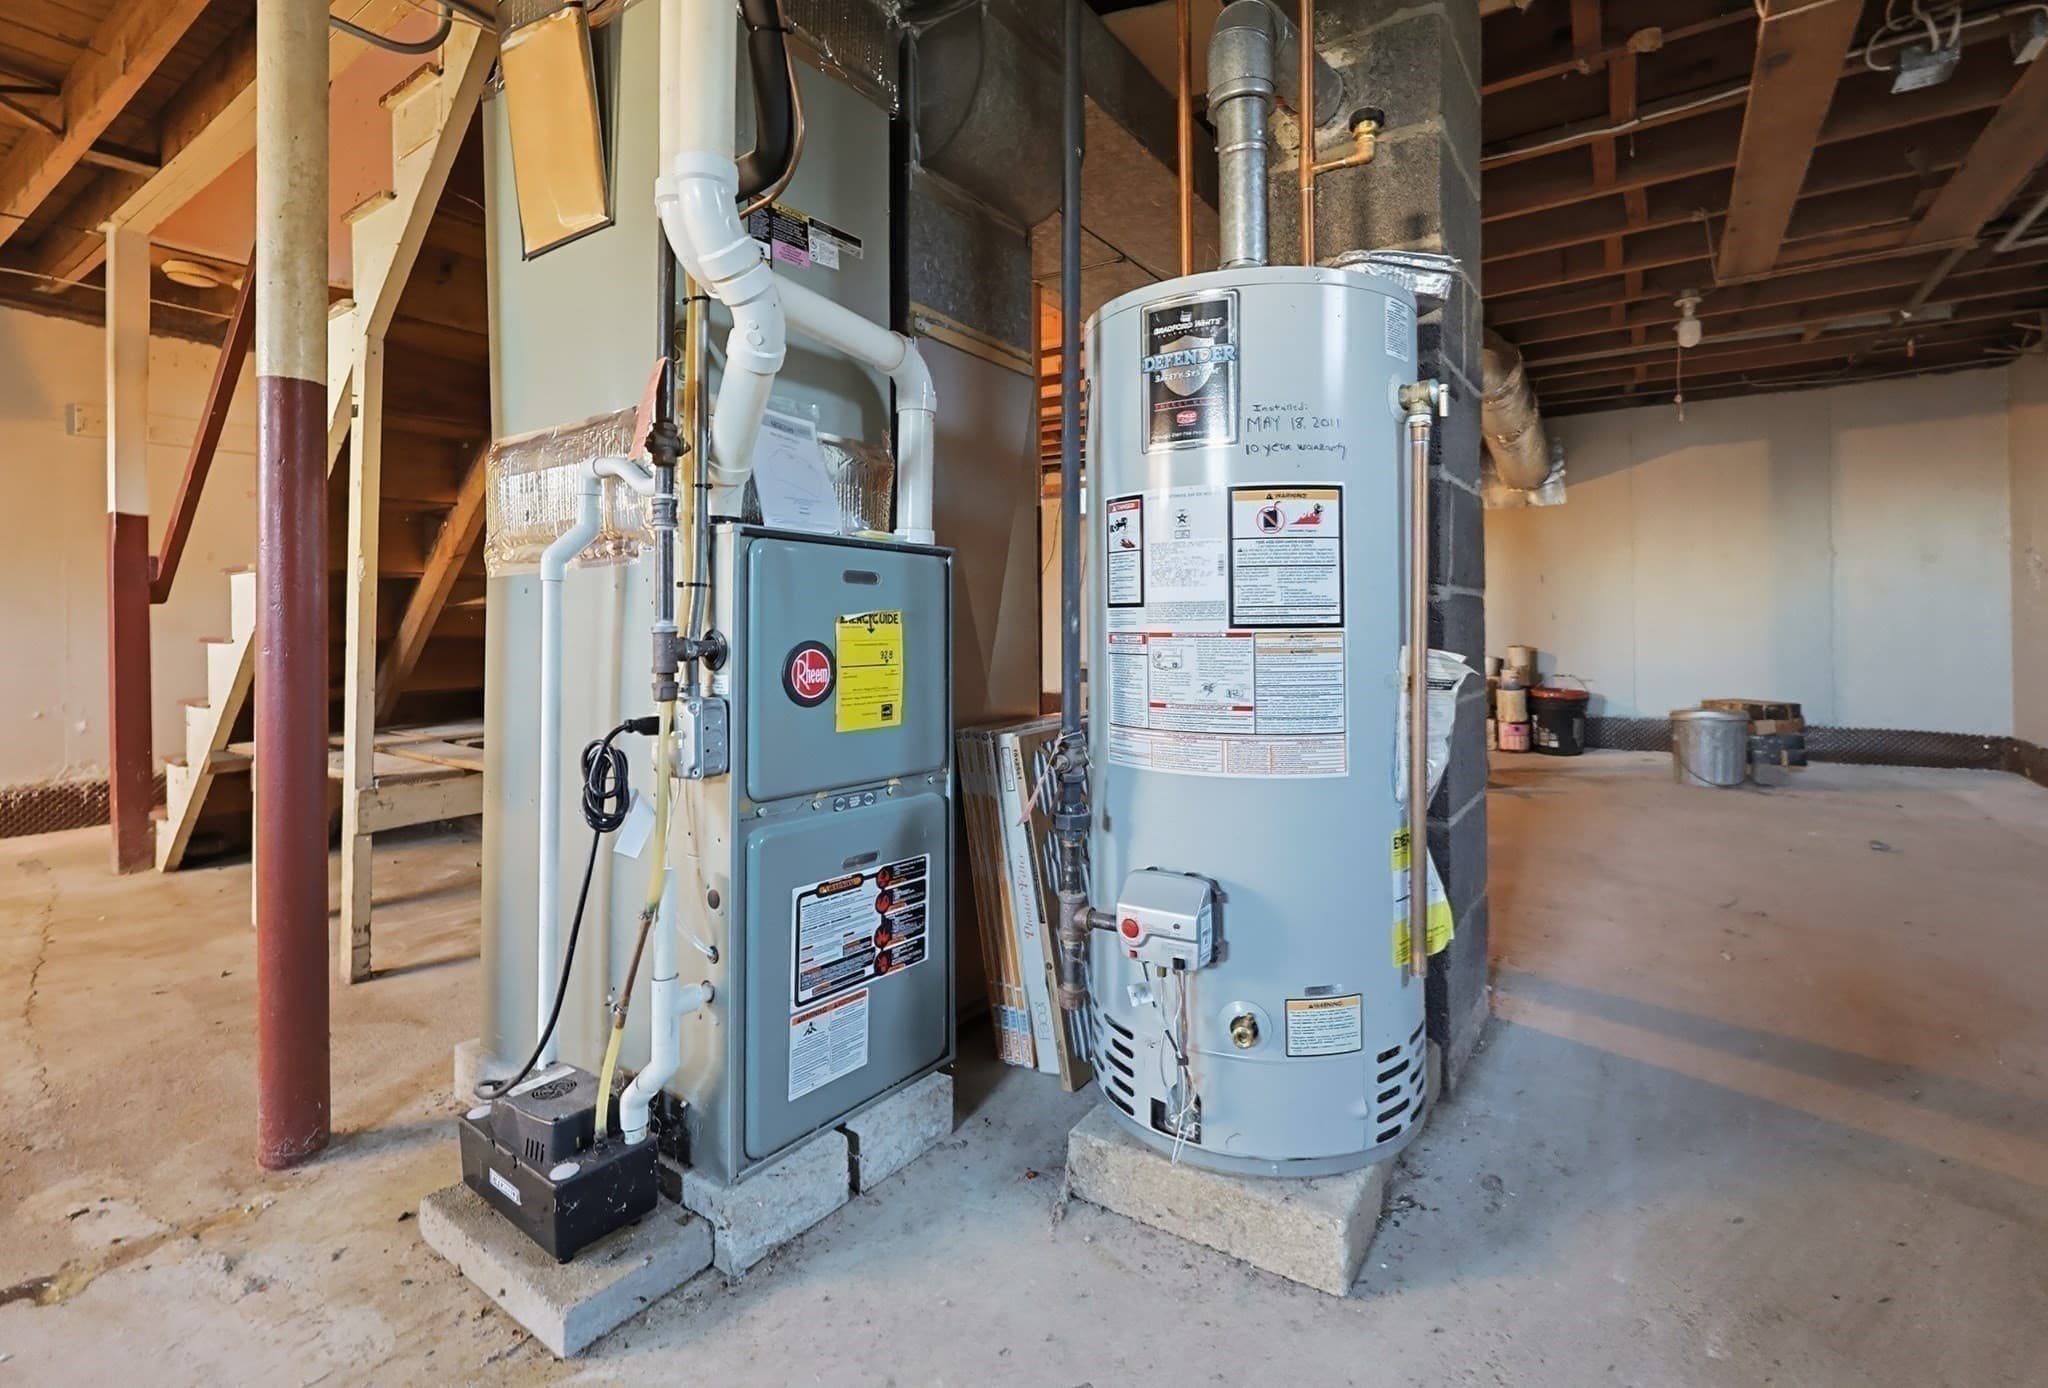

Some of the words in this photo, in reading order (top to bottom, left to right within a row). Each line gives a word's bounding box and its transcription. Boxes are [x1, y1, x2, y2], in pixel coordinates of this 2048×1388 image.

[1153, 321, 1193, 336] BRADFORD
[1194, 317, 1224, 328] WHITE
[1142, 343, 1237, 373] DEFENDER
[1252, 402, 1308, 412] Installed:
[1246, 415, 1280, 432] MAY
[1311, 416, 1340, 429] 2011
[1245, 443, 1260, 456] 10
[796, 650, 829, 690] Rheem
